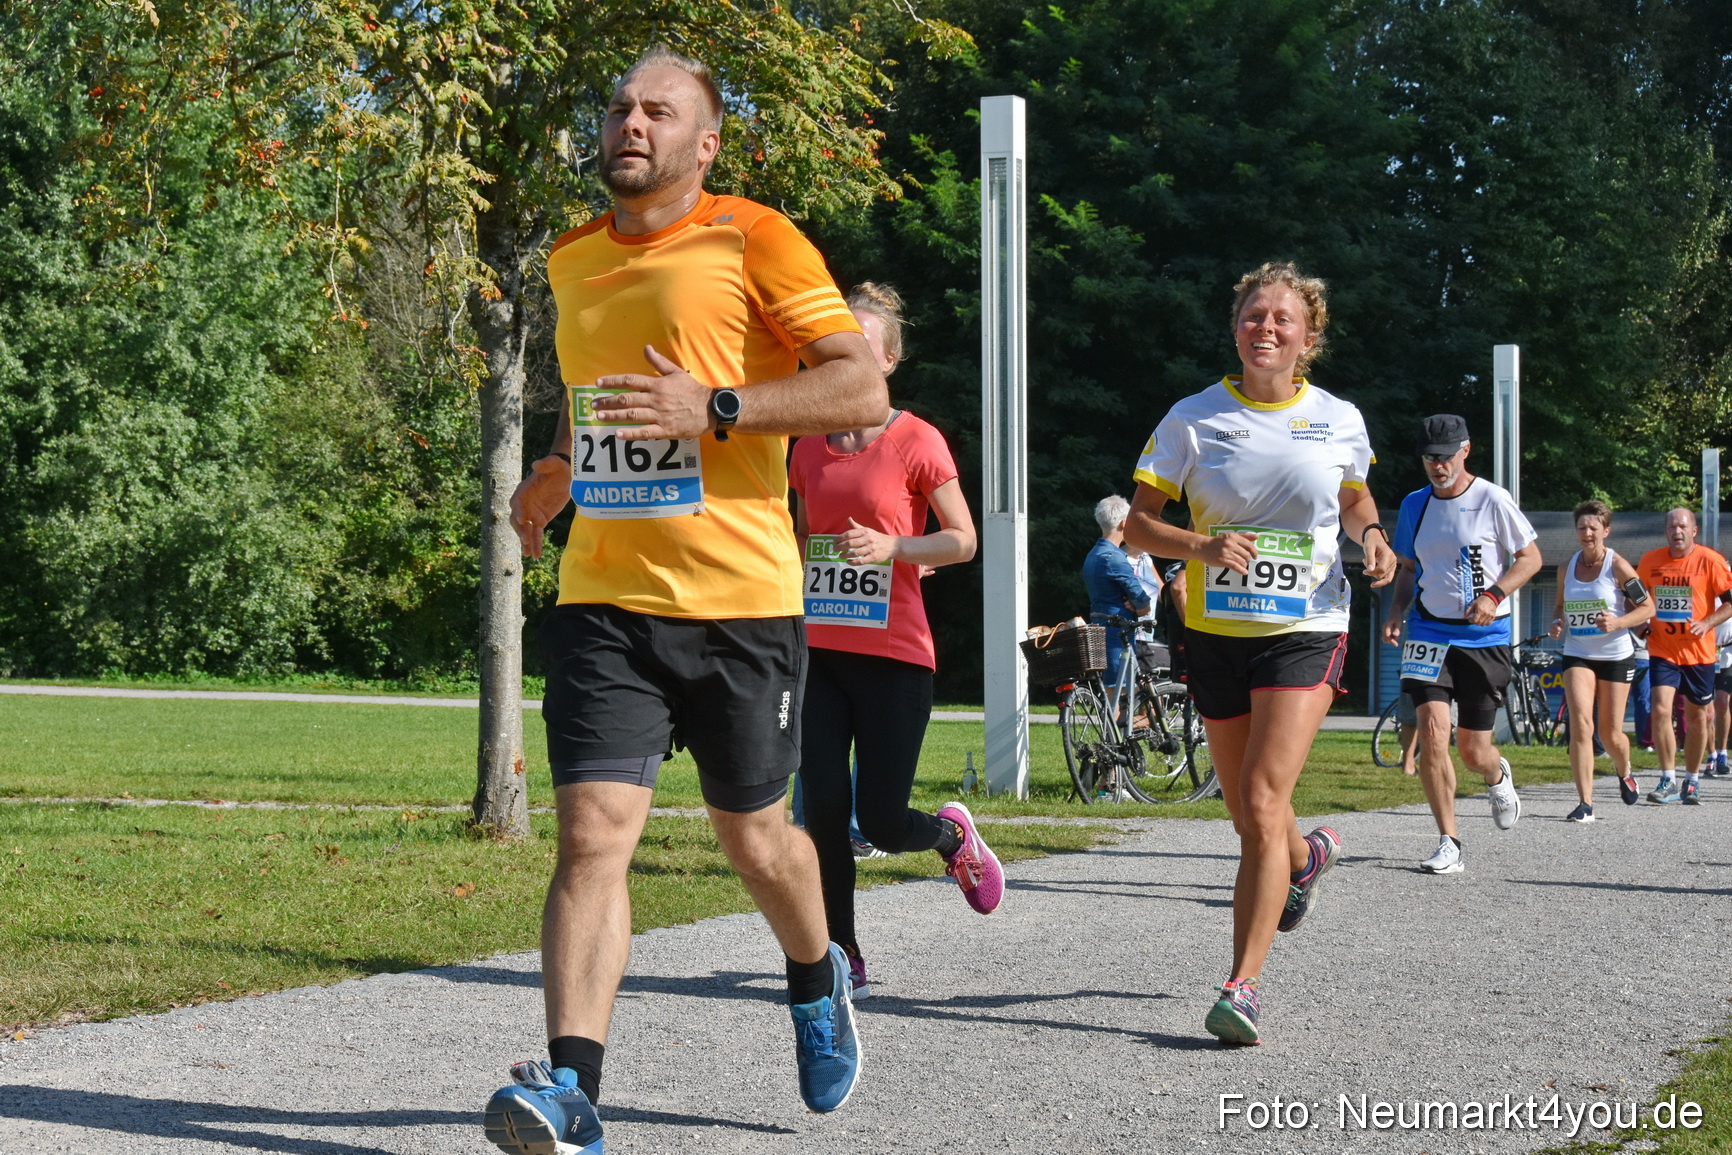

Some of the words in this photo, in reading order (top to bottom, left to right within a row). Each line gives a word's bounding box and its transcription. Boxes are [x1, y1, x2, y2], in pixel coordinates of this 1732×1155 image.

[1291, 420, 1308, 429] 20
[1216, 430, 1250, 440] BOCK
[1292, 435, 1327, 443] Stadtlauf
[581, 433, 681, 473] 2162
[584, 486, 680, 503] ANDREAS
[809, 567, 879, 596] 2186
[1656, 588, 1688, 597] BOCK
[811, 602, 870, 617] CAROLIN
[1227, 596, 1278, 612] MARIA
[1567, 602, 1602, 611] BOCK
[1658, 599, 1688, 610] 2832
[778, 691, 790, 729] adidas
